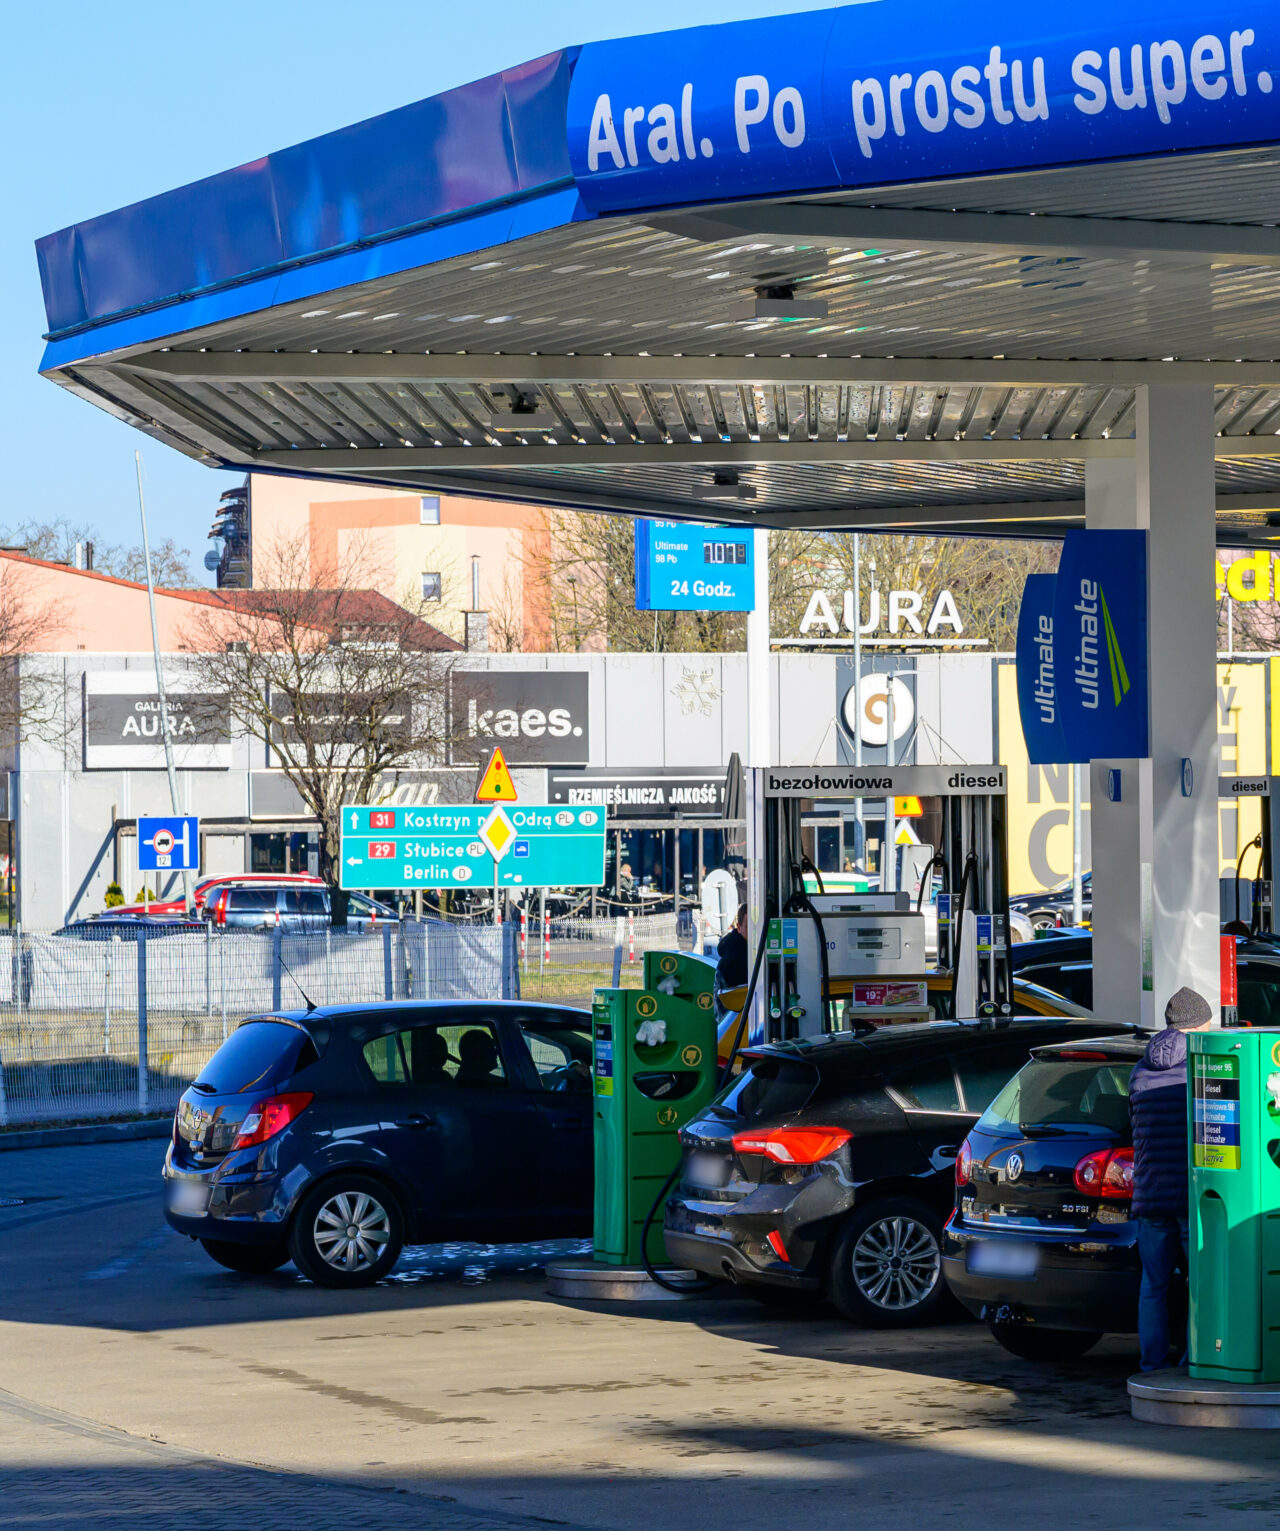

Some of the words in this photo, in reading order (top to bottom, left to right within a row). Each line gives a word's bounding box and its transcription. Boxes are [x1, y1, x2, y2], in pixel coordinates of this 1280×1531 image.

[588, 82, 714, 172] Aral.
[734, 75, 805, 154] Po
[852, 46, 1049, 159] prostu
[1072, 28, 1274, 125] super.
[655, 541, 688, 551] Ultimate
[655, 554, 665, 563] 98
[667, 554, 678, 564] Pb
[671, 580, 689, 596] 24
[693, 580, 736, 597] Godz.
[799, 589, 964, 634] AURA
[1075, 578, 1099, 710] ultimate
[1034, 615, 1055, 724] ultimate
[468, 699, 583, 738] kaes.
[769, 772, 893, 791] bezołowiowa
[948, 771, 1004, 789] diesel
[1232, 781, 1267, 793] diesel
[568, 785, 664, 805] RZEMIEŚLNICZA
[669, 784, 717, 804] JAKOŚĆ
[376, 814, 389, 826] 31
[404, 813, 471, 831] Kostrzyn
[512, 812, 552, 830] Odrą
[558, 814, 571, 824] PL
[585, 814, 592, 824] D
[375, 845, 390, 857] 29
[404, 842, 464, 858] Słubice
[470, 845, 482, 855] PL
[404, 864, 449, 880] Berlin
[459, 868, 466, 879] D
[865, 991, 876, 1000] 19
[1208, 1064, 1223, 1072] super
[1224, 1063, 1232, 1071] 95
[1205, 1085, 1221, 1093] diesel
[1075, 1205, 1089, 1213] FSI
